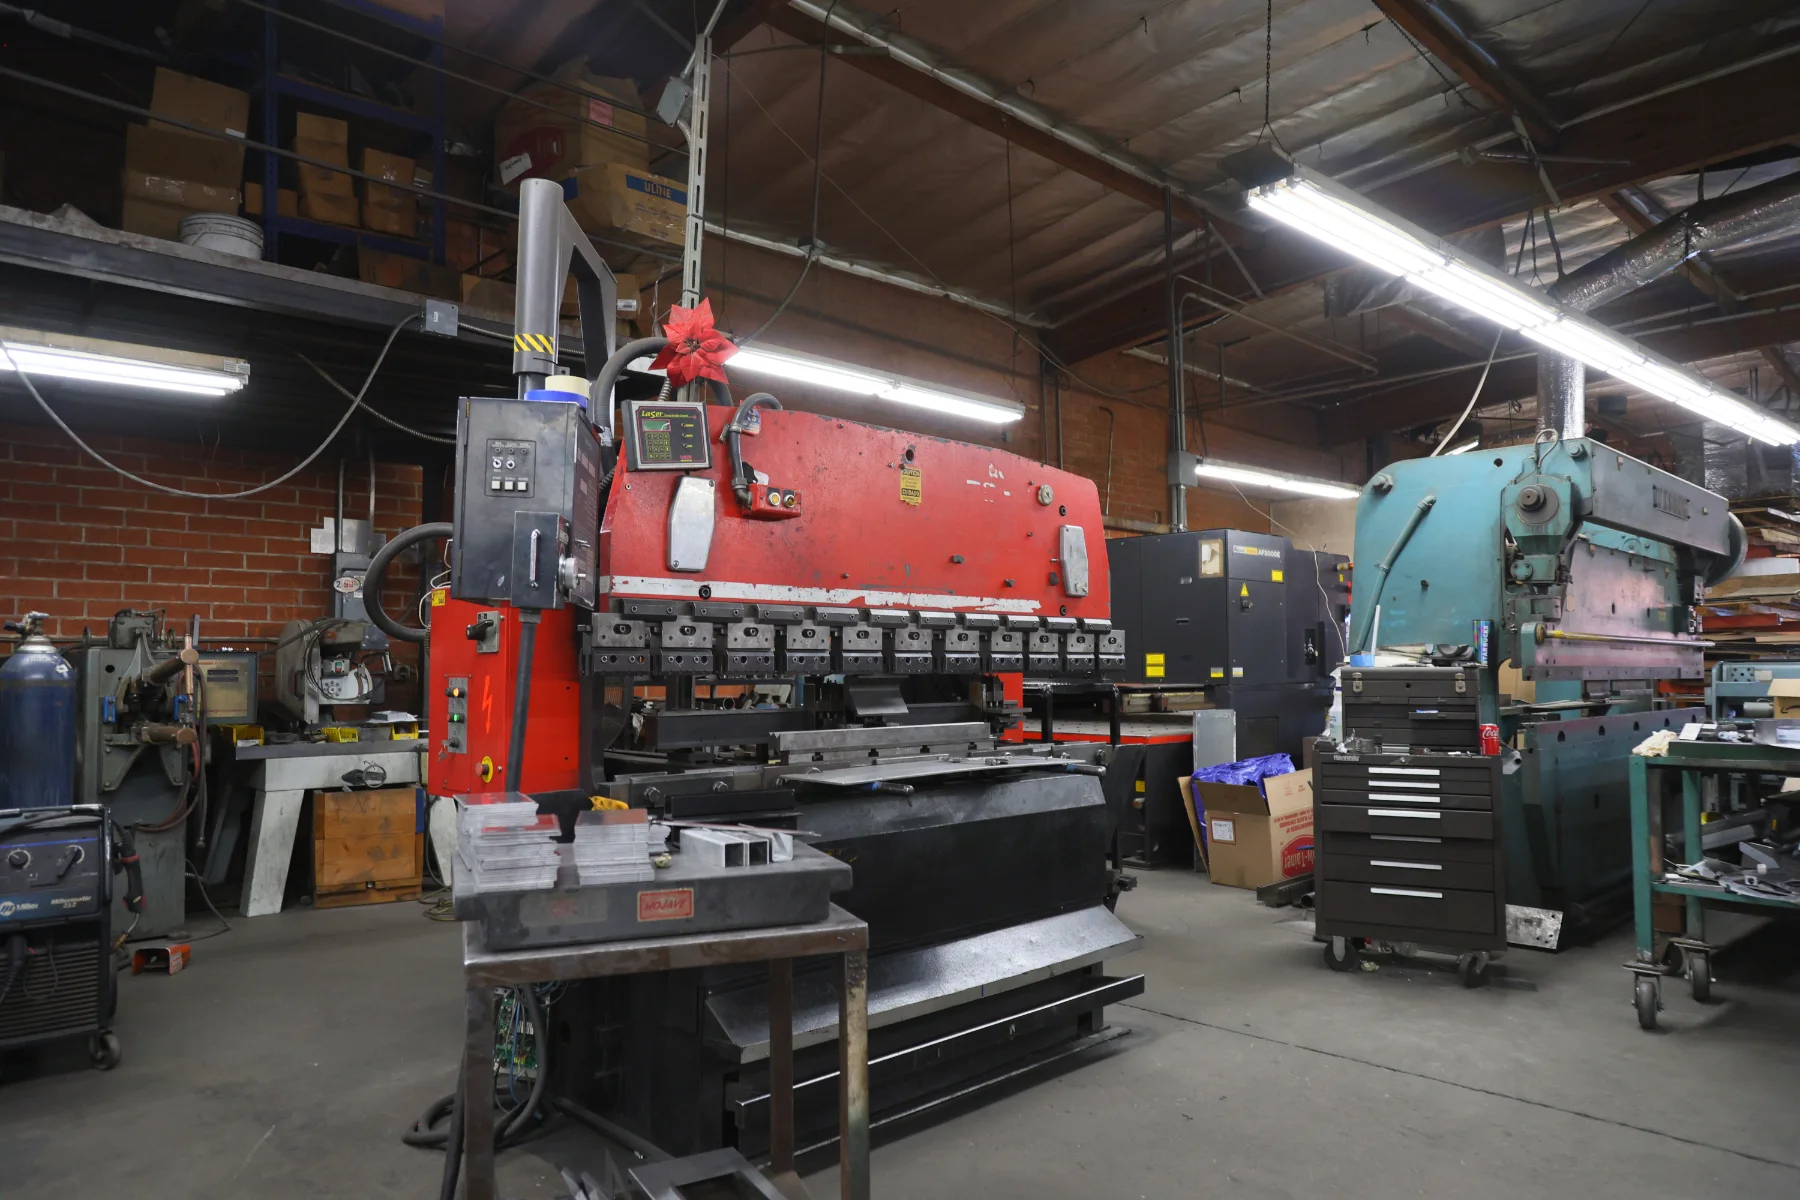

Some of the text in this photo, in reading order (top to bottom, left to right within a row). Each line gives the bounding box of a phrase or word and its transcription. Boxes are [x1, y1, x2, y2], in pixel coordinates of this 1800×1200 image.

[644, 181, 672, 199] ULINE
[641, 410, 664, 418] Laser
[16, 903, 39, 911] Miller
[643, 898, 687, 911] MOJAVE
